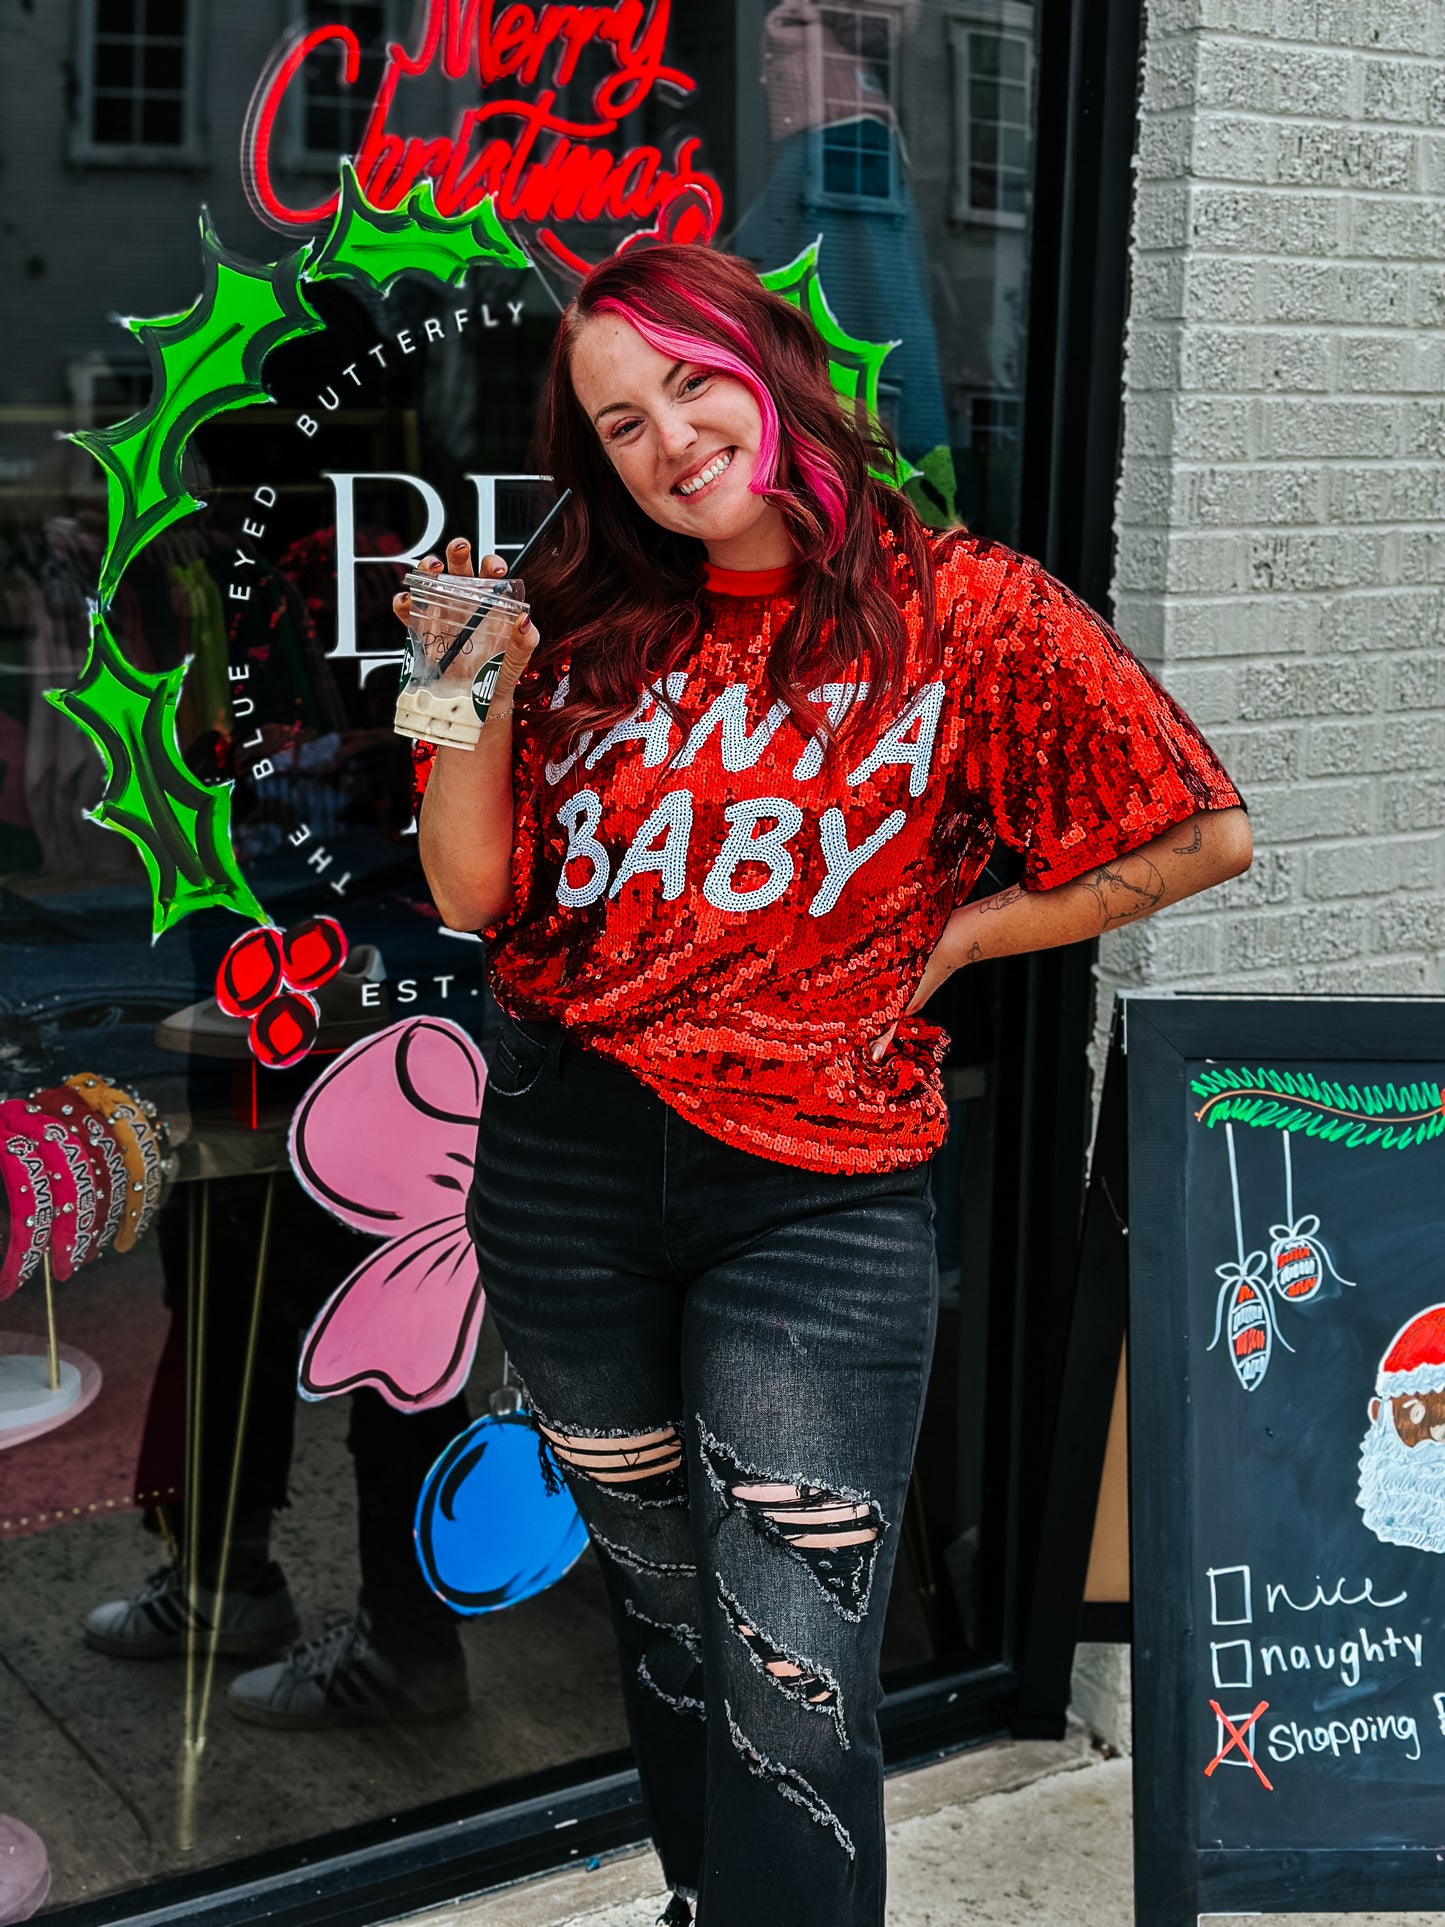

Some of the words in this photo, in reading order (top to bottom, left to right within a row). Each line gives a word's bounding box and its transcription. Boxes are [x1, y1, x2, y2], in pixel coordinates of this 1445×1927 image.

[387, 0, 697, 120] Merry
[252, 24, 724, 277] Christmas
[295, 300, 526, 438] BUTTERFLY
[229, 484, 279, 602] EYED
[228, 664, 275, 780] BLUE
[287, 824, 352, 897] THE
[555, 788, 907, 918] BABY
[361, 974, 480, 1007] EST.
[1265, 1575, 1409, 1613] nice
[1260, 1626, 1423, 1688] naughty
